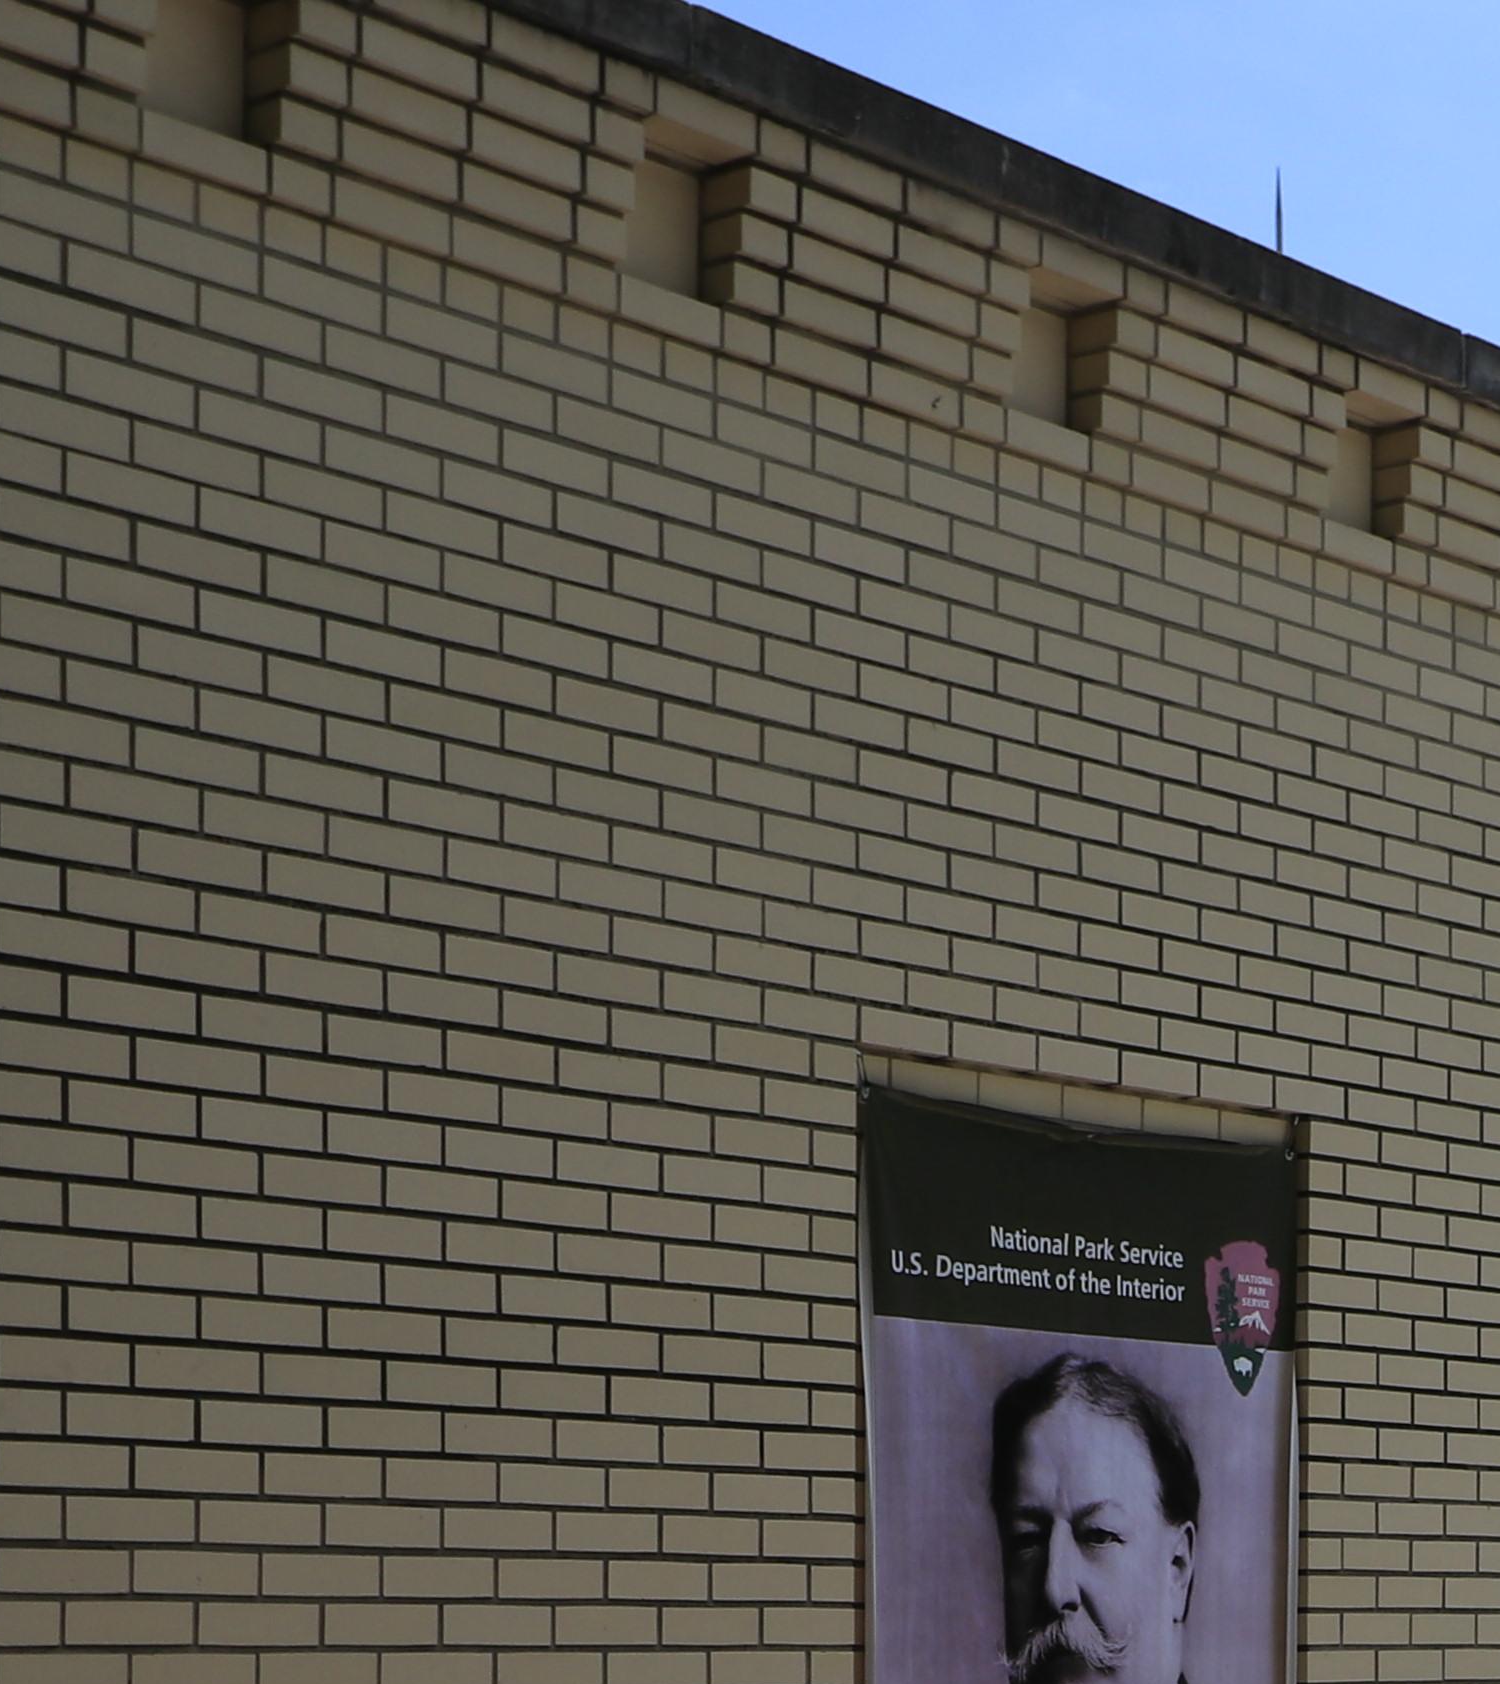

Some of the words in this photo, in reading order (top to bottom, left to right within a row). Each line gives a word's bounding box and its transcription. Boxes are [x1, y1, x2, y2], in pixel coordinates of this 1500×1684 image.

[990, 1225, 1069, 1257] National
[1074, 1235, 1115, 1262] Park
[1119, 1240, 1184, 1270] Service
[890, 1249, 928, 1277] U.S.
[935, 1254, 1051, 1290] Department
[1055, 1268, 1077, 1291] of
[1080, 1270, 1111, 1296] the
[1116, 1276, 1185, 1302] Interior
